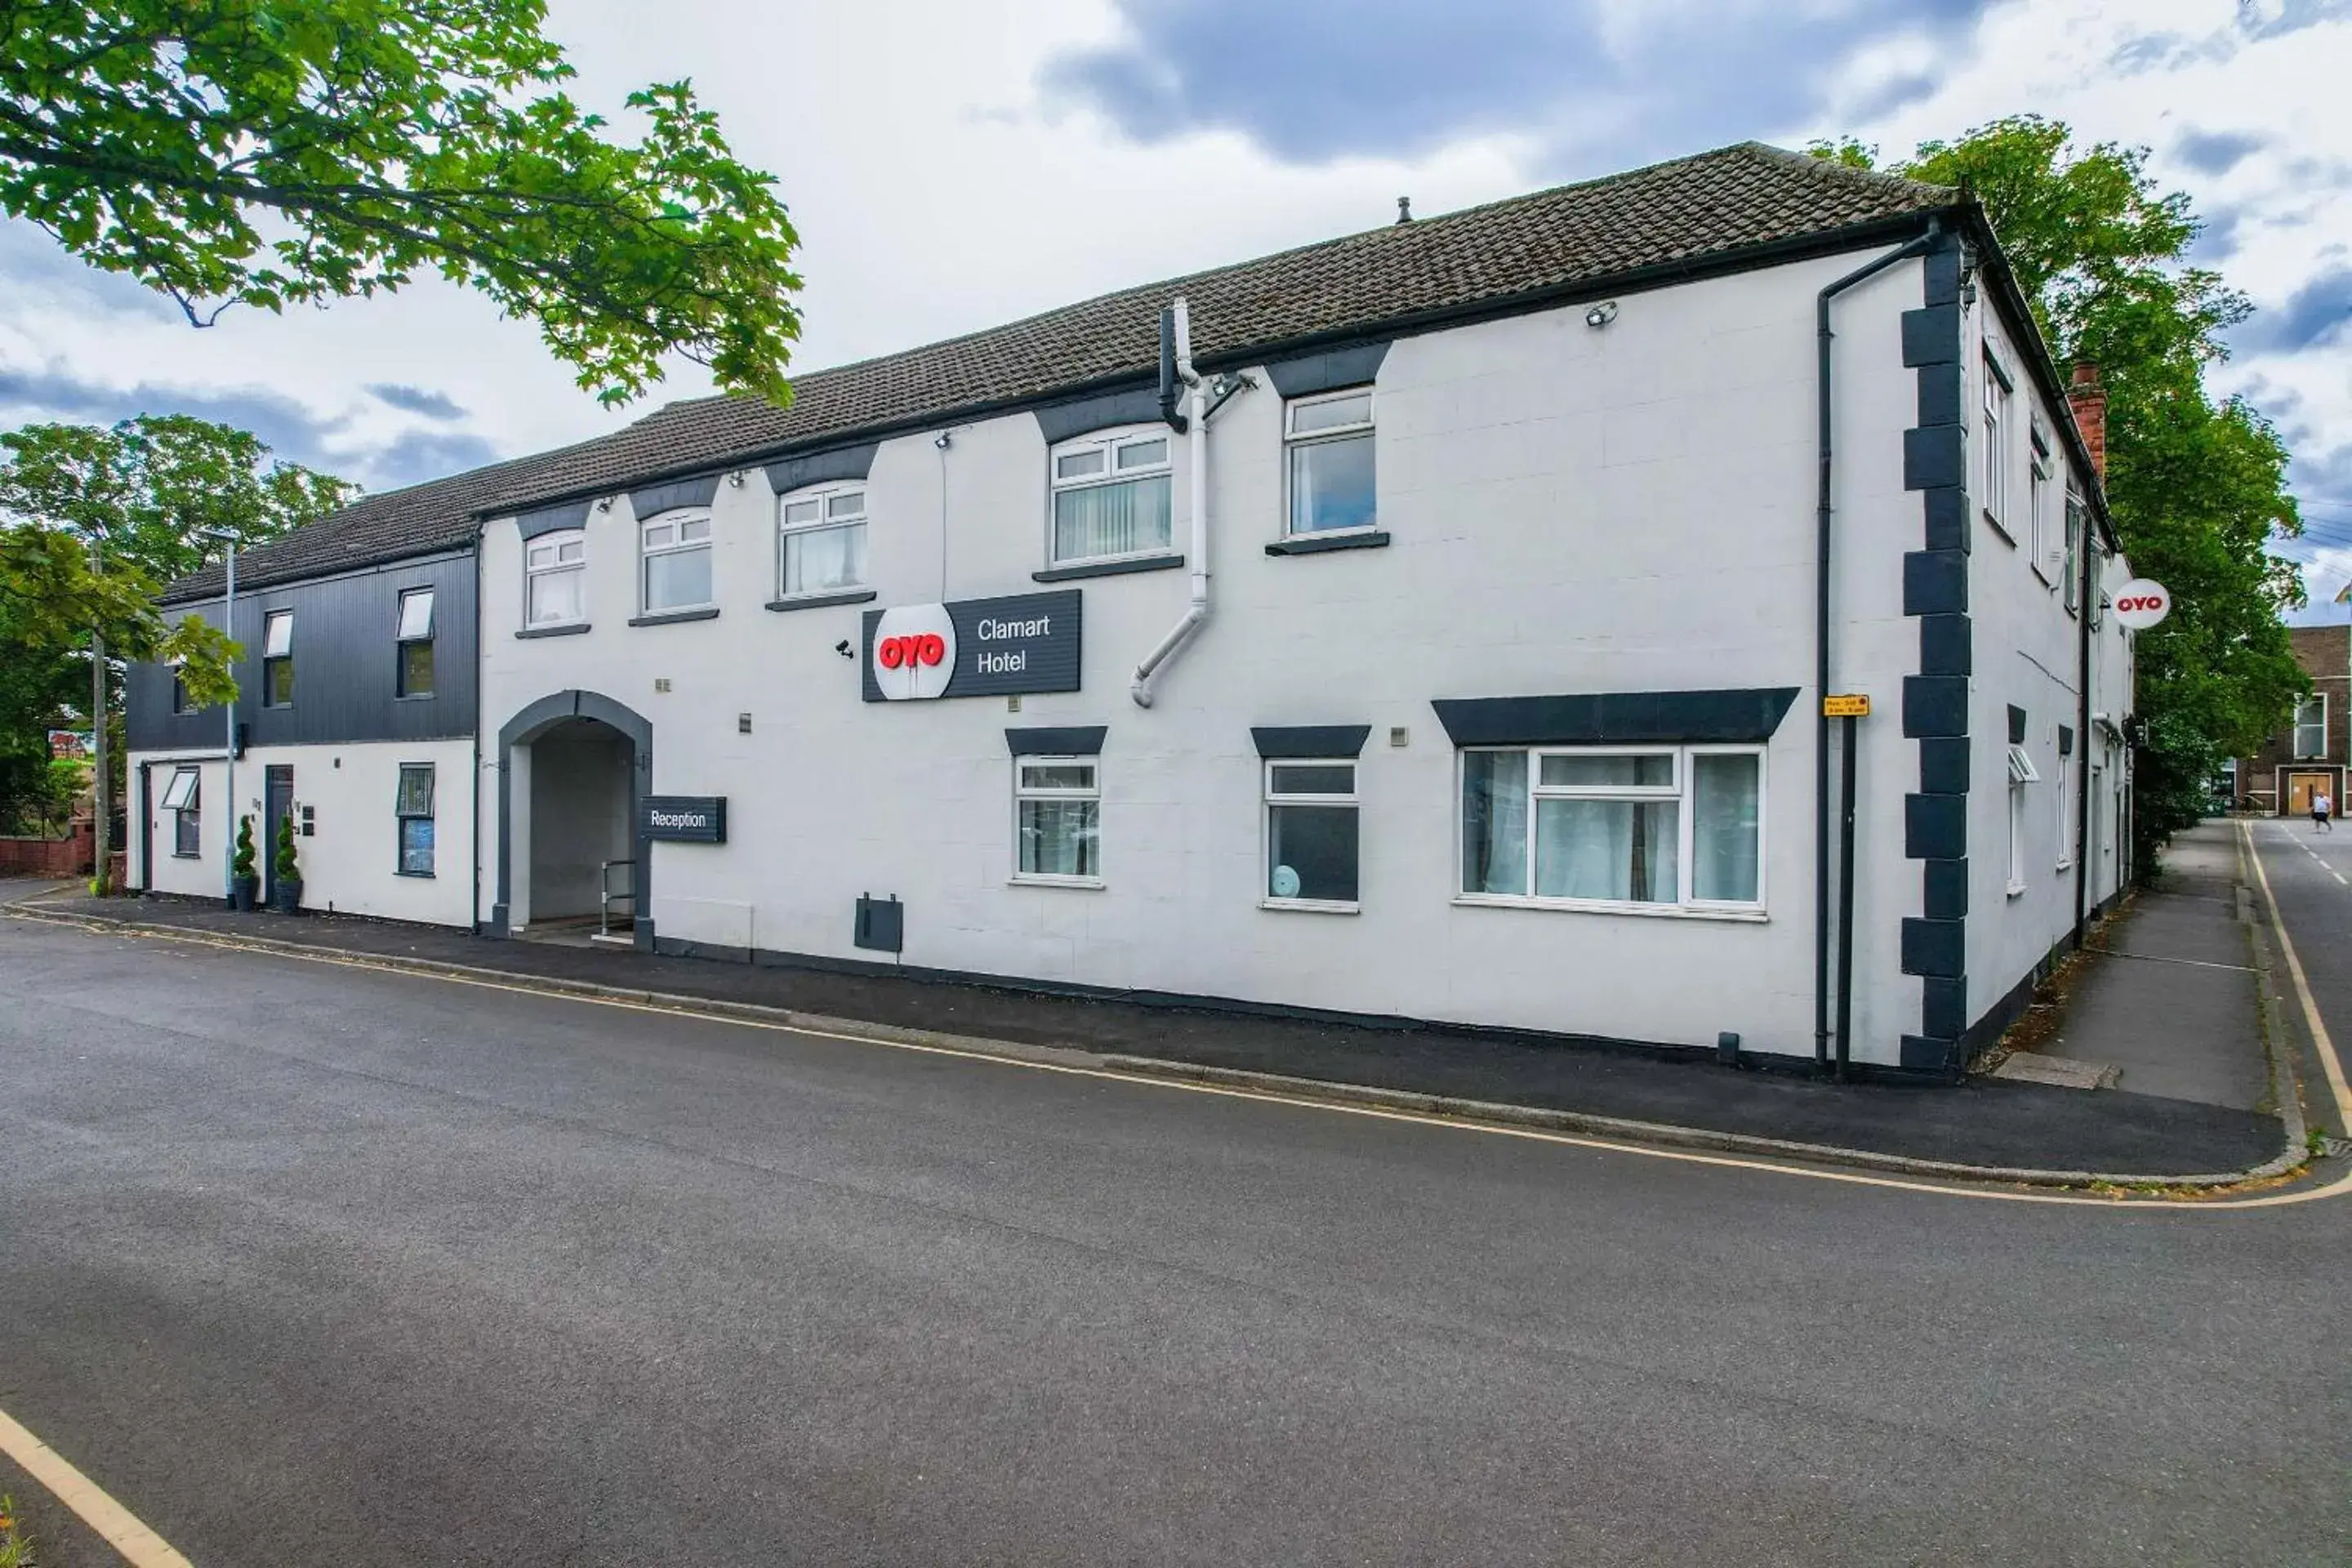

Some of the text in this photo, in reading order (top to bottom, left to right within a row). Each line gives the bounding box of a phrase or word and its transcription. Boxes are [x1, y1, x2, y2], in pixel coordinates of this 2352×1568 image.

[2118, 596, 2163, 612] OYO
[978, 616, 1050, 640] Clamart
[880, 634, 945, 669] OYO
[978, 650, 1026, 673] Hotel
[652, 810, 706, 830] Reception
